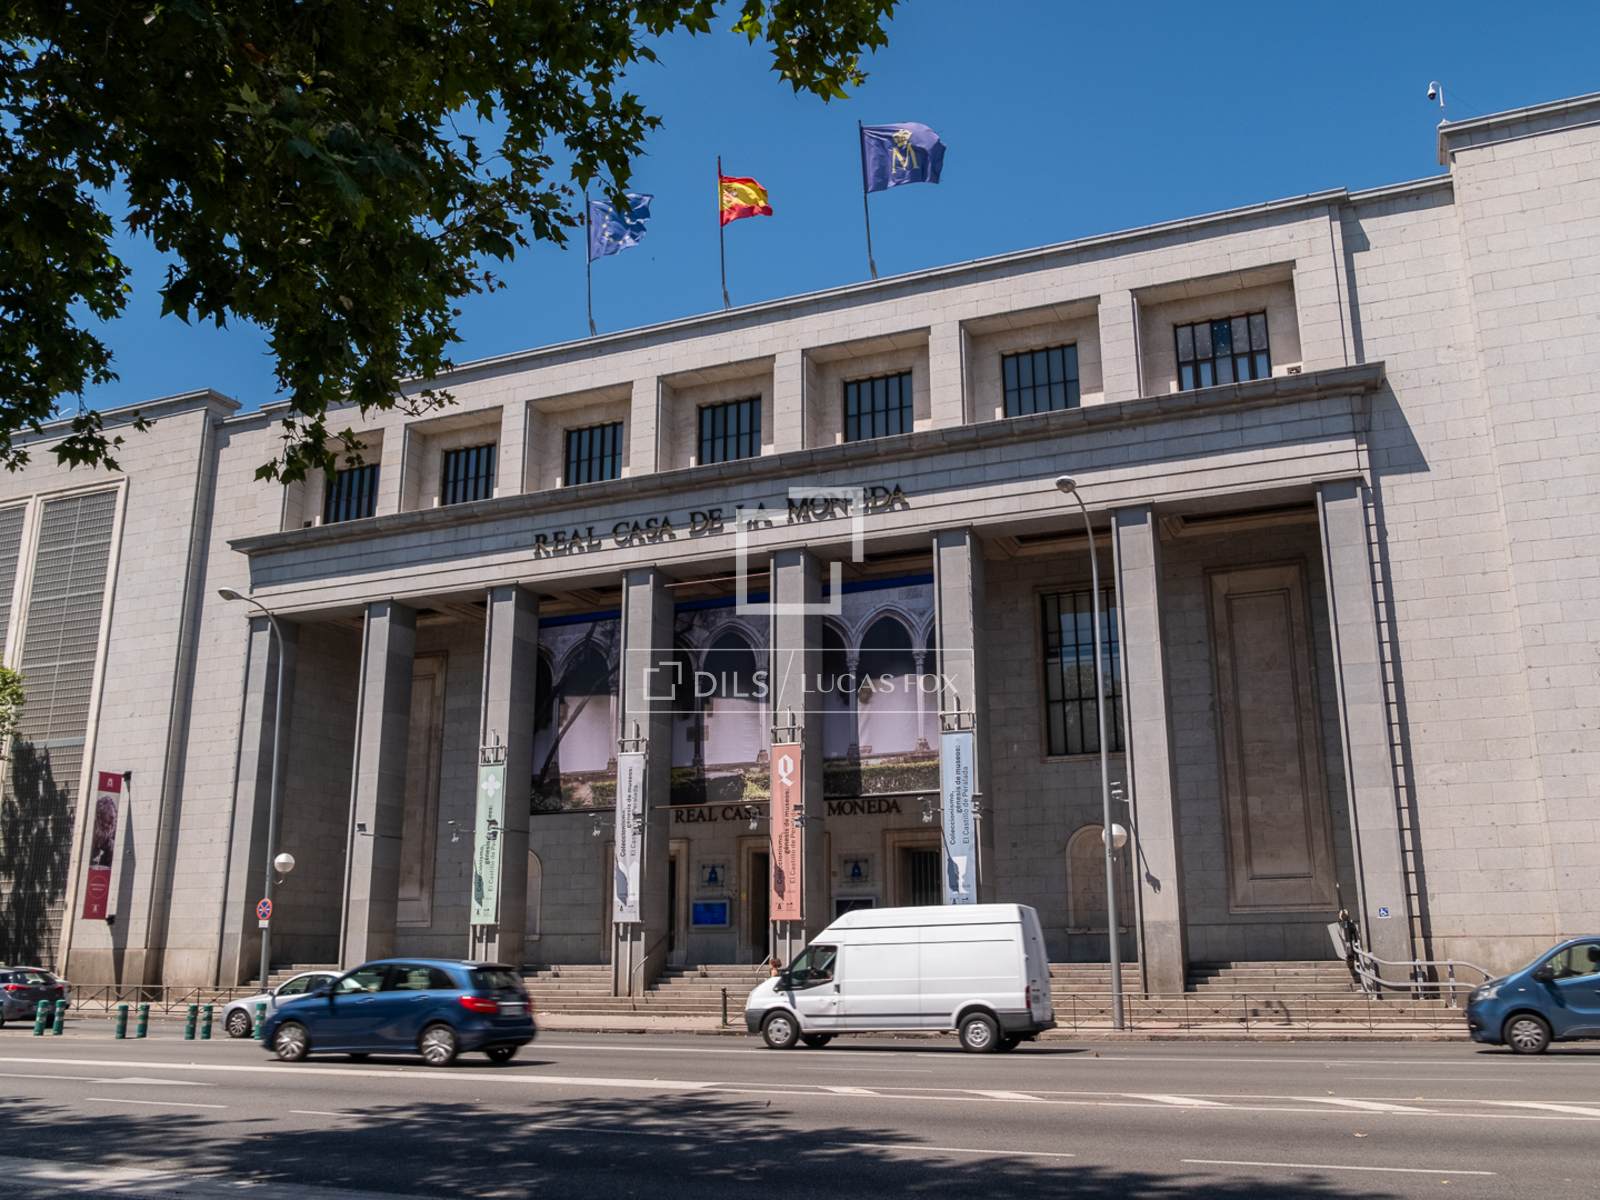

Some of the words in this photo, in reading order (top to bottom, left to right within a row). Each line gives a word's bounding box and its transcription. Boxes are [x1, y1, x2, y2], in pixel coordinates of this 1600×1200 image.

[534, 526, 602, 558] REAL
[612, 516, 676, 546] CASA
[689, 508, 724, 538] DE
[787, 484, 910, 524] MONEDA
[675, 807, 717, 823] REAL
[827, 799, 903, 817] MONEDA
